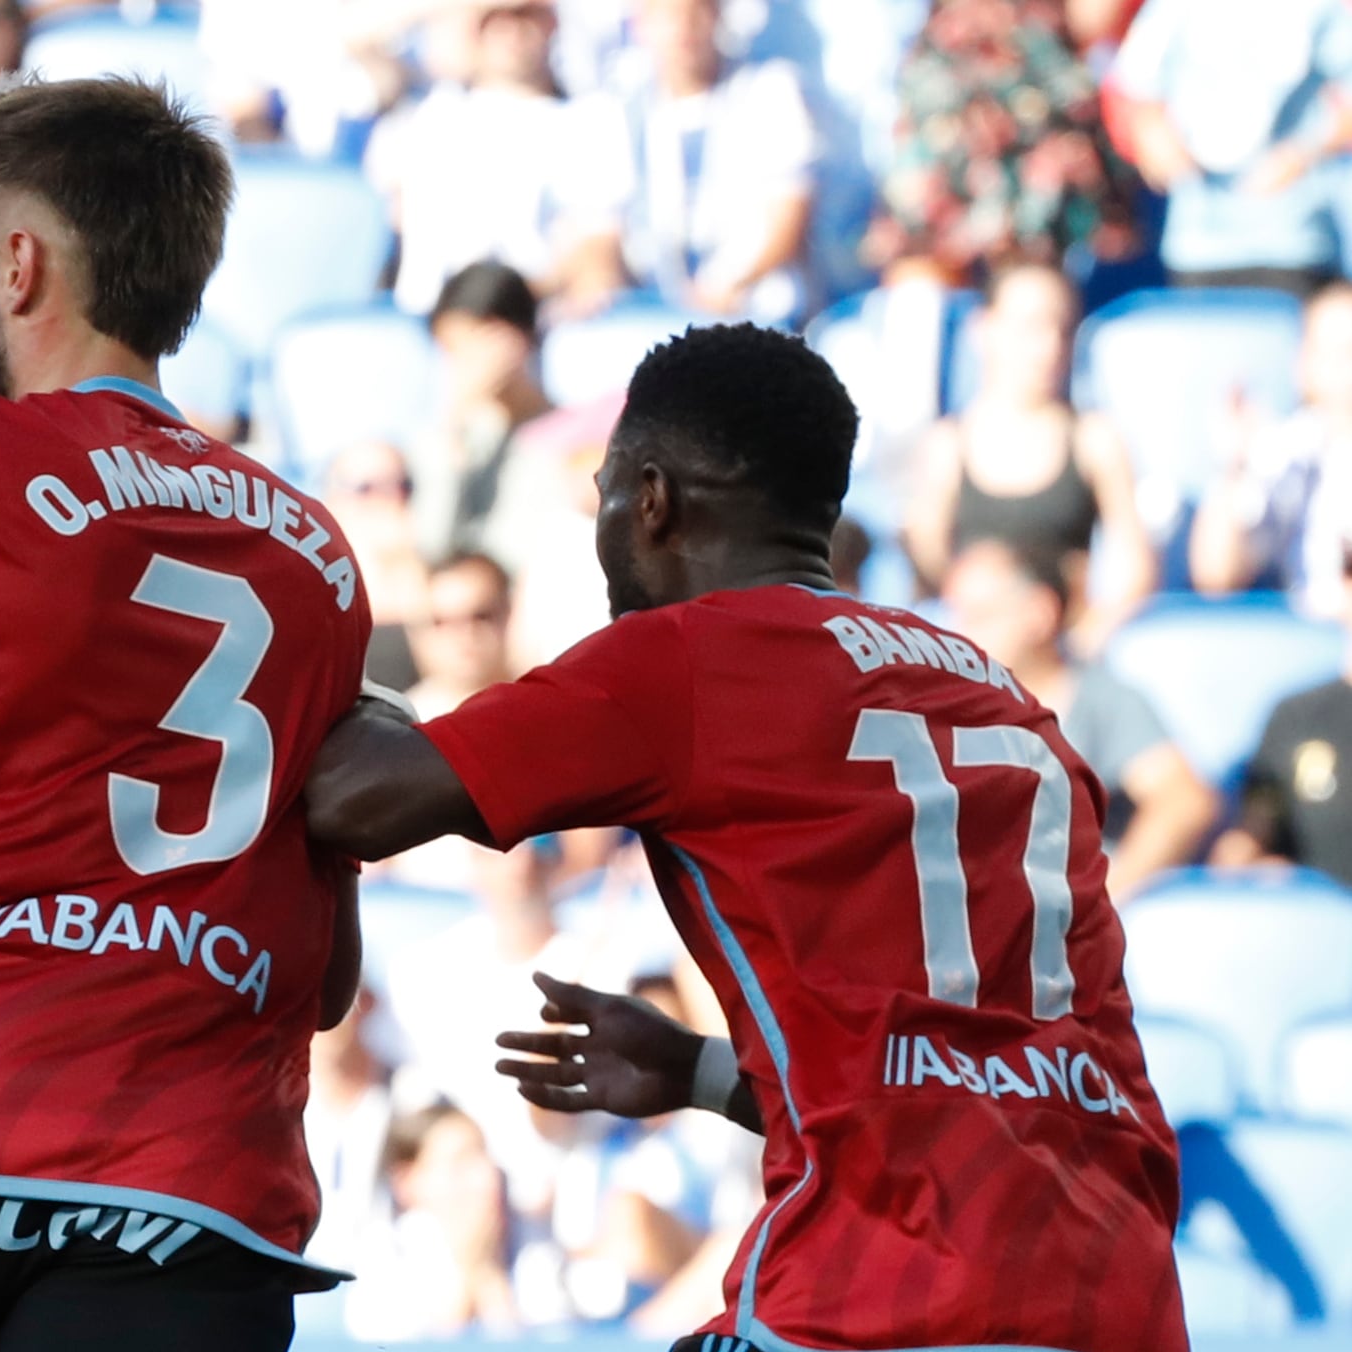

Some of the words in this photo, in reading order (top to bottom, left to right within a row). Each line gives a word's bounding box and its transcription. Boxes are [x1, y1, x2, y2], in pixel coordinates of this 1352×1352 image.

[109, 553, 274, 876] 3
[821, 615, 1026, 704] BAMBA
[847, 708, 1075, 1021] 17
